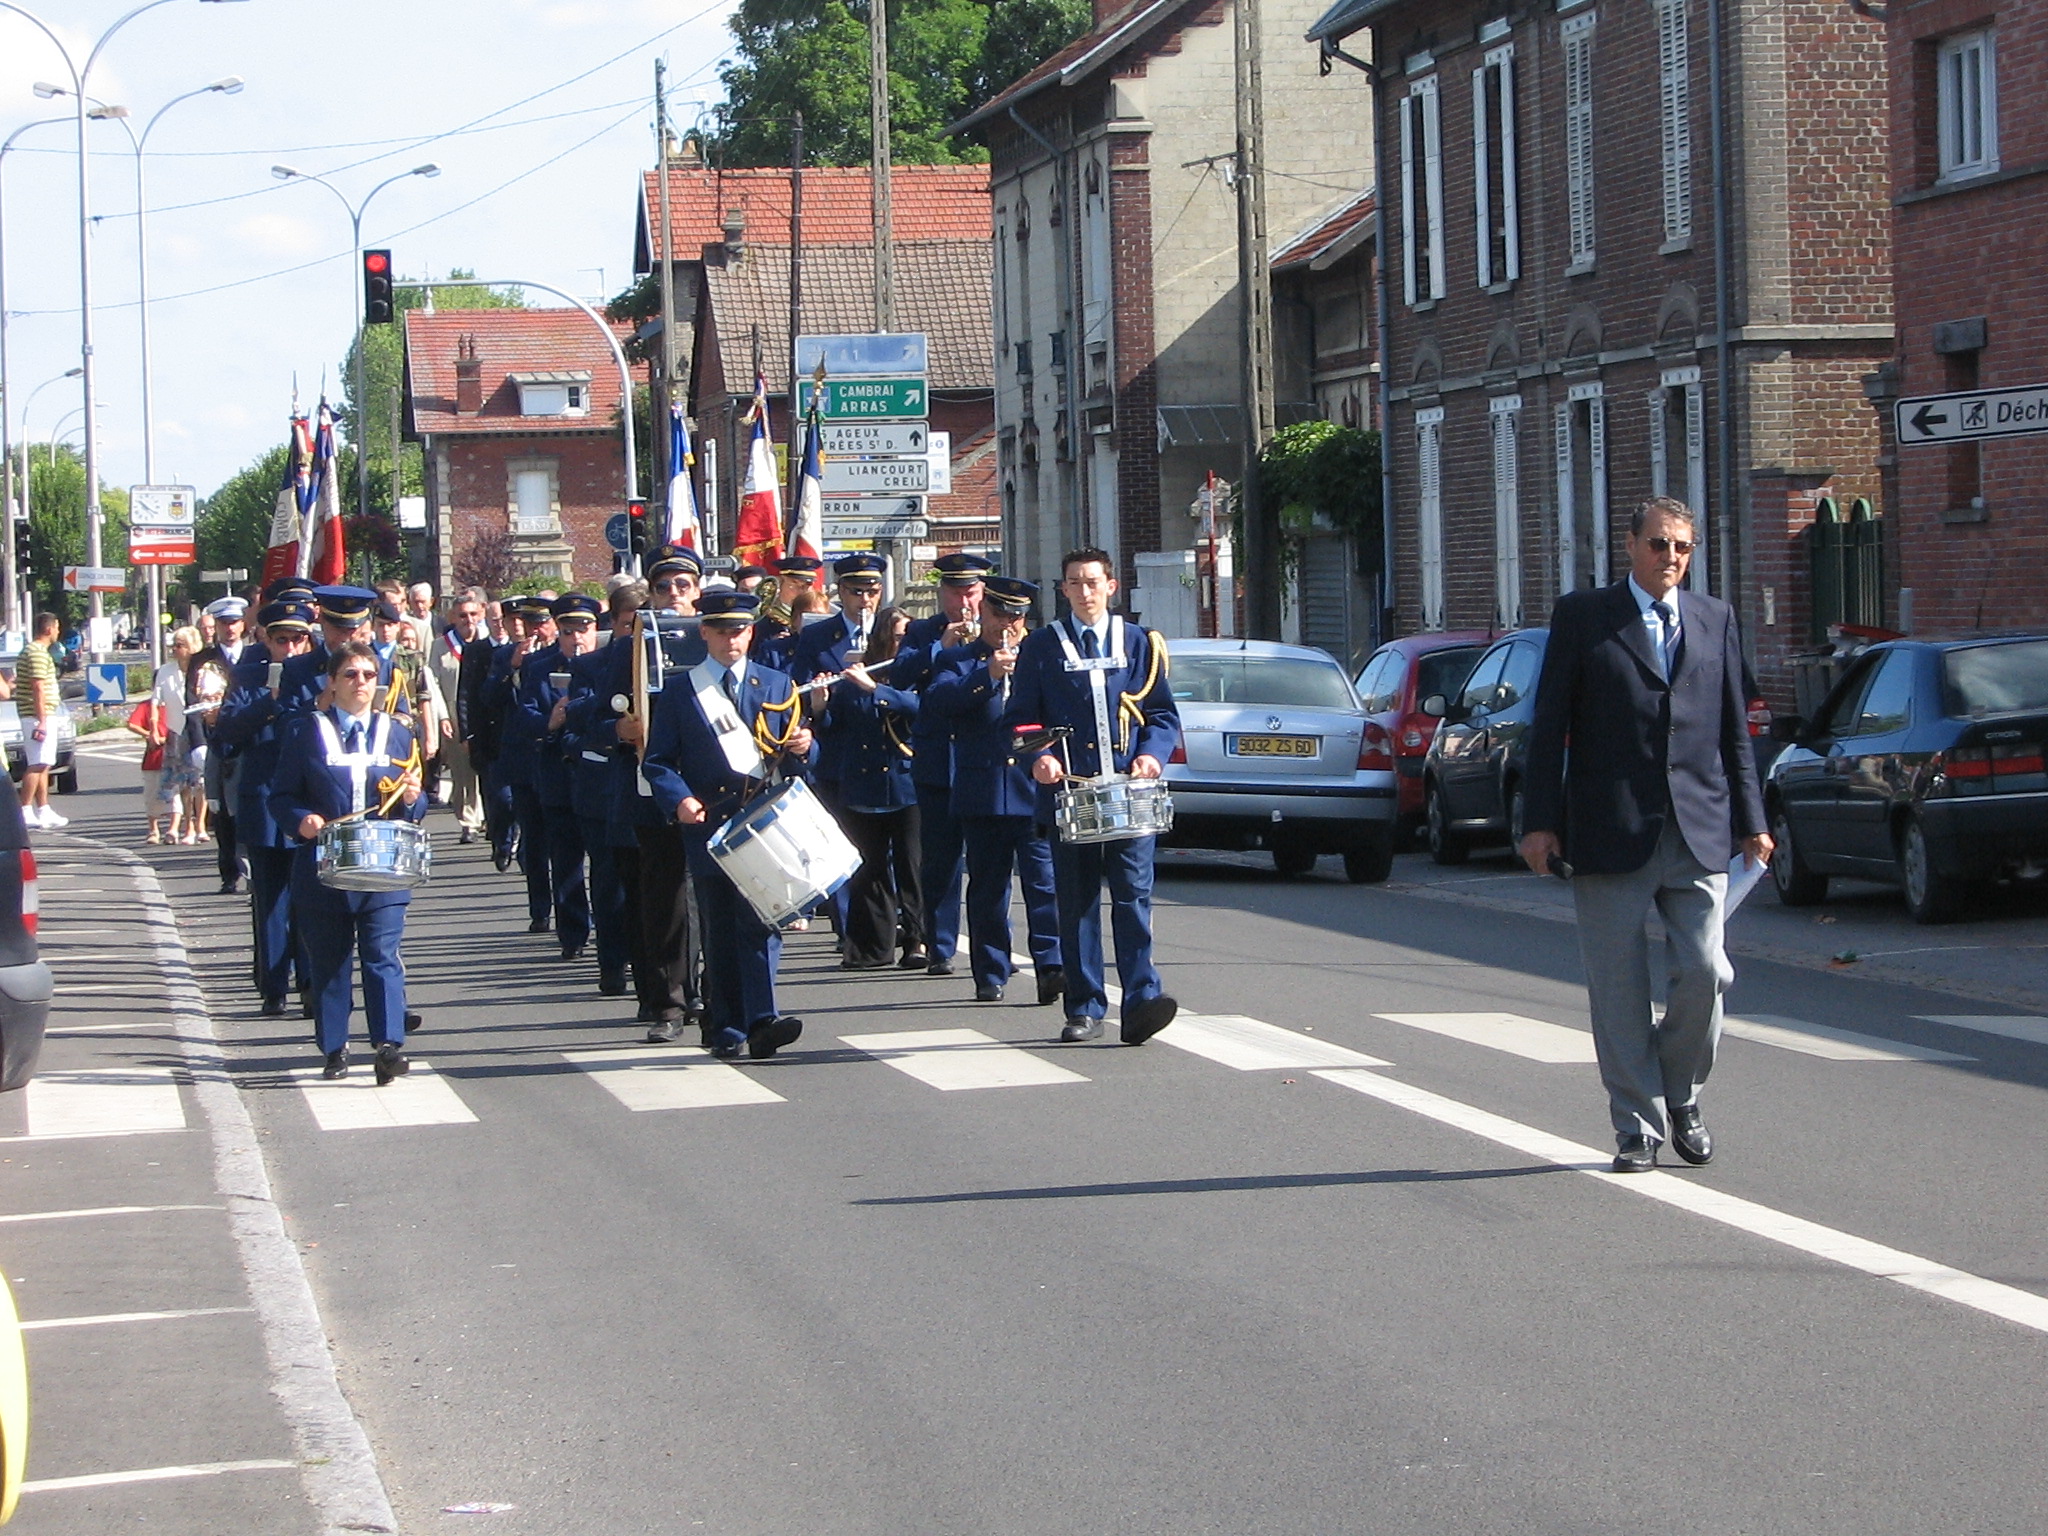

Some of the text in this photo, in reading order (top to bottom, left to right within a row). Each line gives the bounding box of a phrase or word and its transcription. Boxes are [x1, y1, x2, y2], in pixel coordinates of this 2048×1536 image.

[839, 384, 894, 398] CAMBRAI
[840, 400, 888, 413] ARRAS
[1999, 400, 2048, 422] Déch
[836, 428, 880, 438] AGEUX
[886, 440, 898, 450] D.
[848, 464, 923, 475] LIANCOURT
[884, 477, 924, 487] CREIL
[824, 502, 861, 512] RRON
[831, 525, 858, 535] Zone
[864, 524, 923, 535] Industrielle
[1239, 738, 1311, 753] 9032 ZS 60
